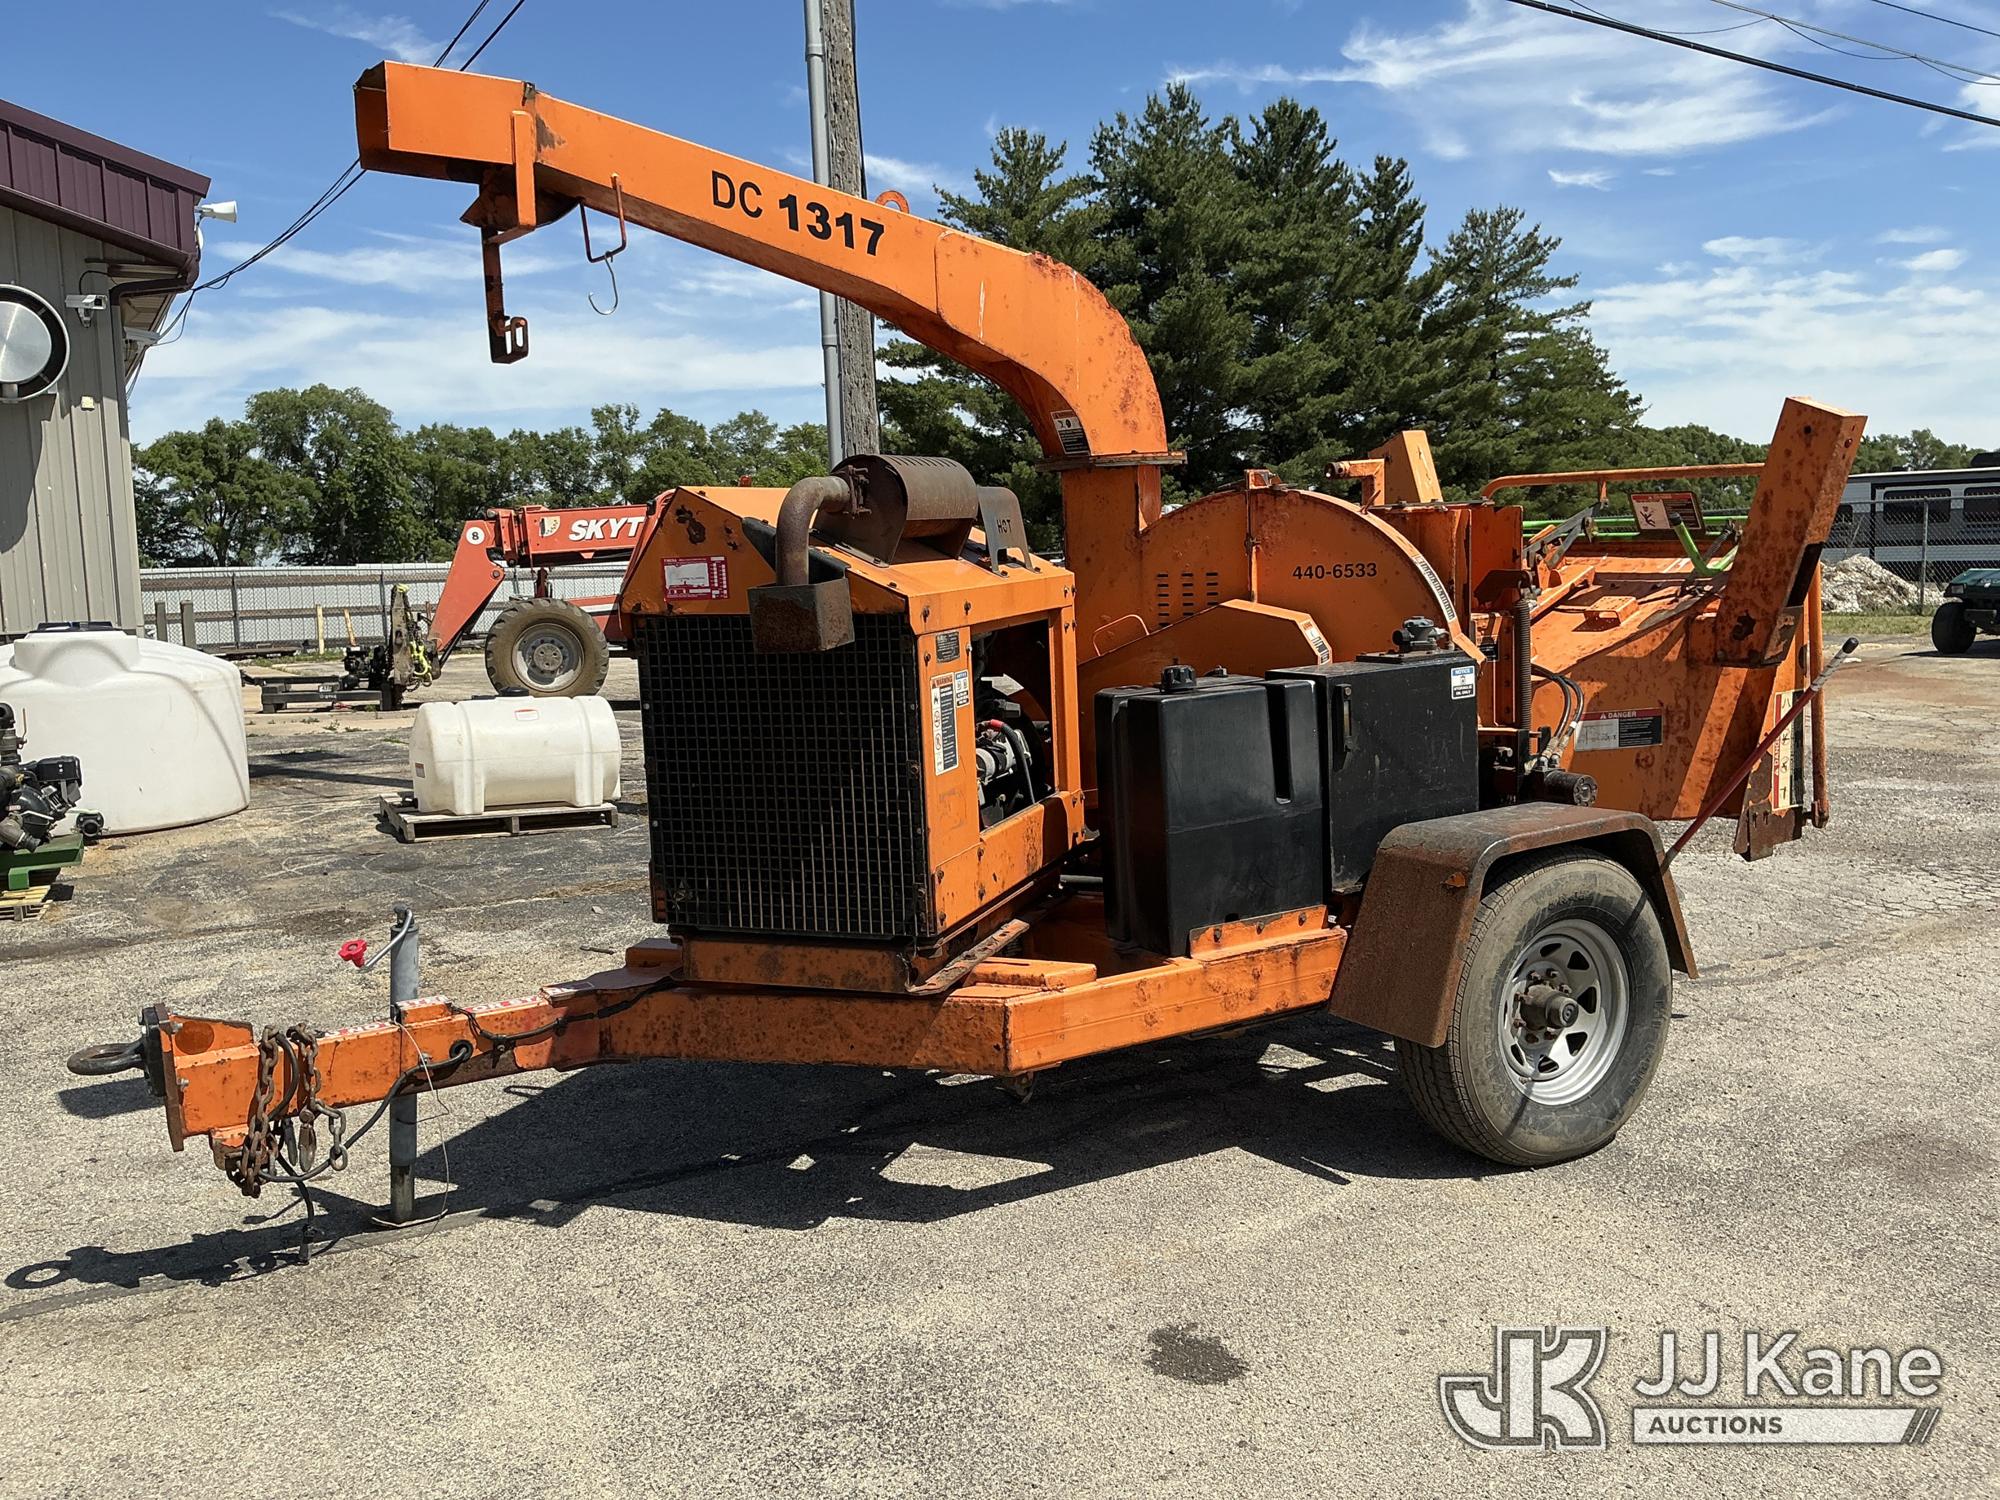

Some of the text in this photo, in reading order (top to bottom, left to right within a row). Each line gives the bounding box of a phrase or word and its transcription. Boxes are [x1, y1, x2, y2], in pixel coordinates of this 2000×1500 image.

[711, 169, 885, 256] DC 1317
[996, 519, 1012, 534] HOT
[471, 531, 480, 541] 8
[1292, 562, 1377, 580] 440-6533
